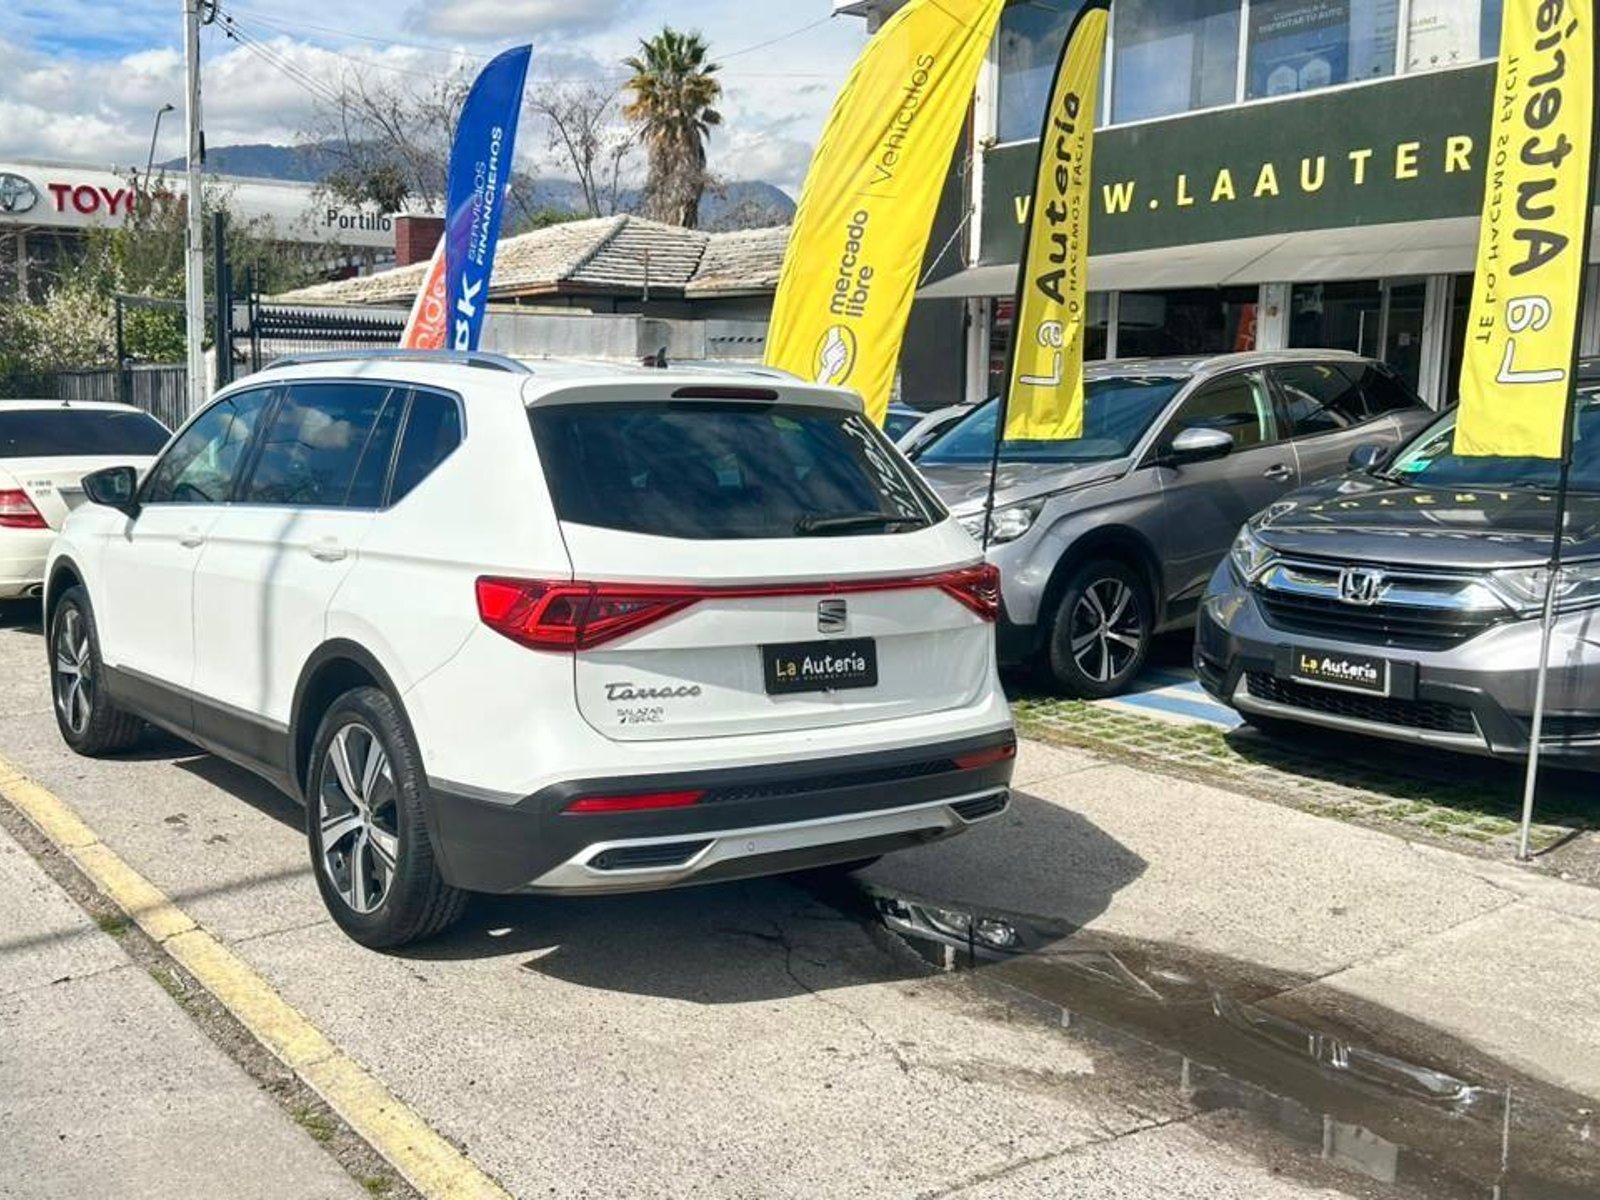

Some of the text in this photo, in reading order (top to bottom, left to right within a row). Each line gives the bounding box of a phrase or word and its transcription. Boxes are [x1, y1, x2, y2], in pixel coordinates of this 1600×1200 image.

[326, 209, 391, 232] Portillo
[468, 160, 487, 262] SERVICIOS
[475, 126, 503, 266] FINANCIEROS
[829, 208, 869, 316] mercado
[1069, 196, 1081, 291] HACEMOS
[845, 264, 874, 318] libre
[1019, 319, 1062, 386] La
[604, 682, 702, 701] Tarraco
[775, 658, 797, 677] La
[801, 652, 866, 675] Autería
[1300, 654, 1318, 669] La
